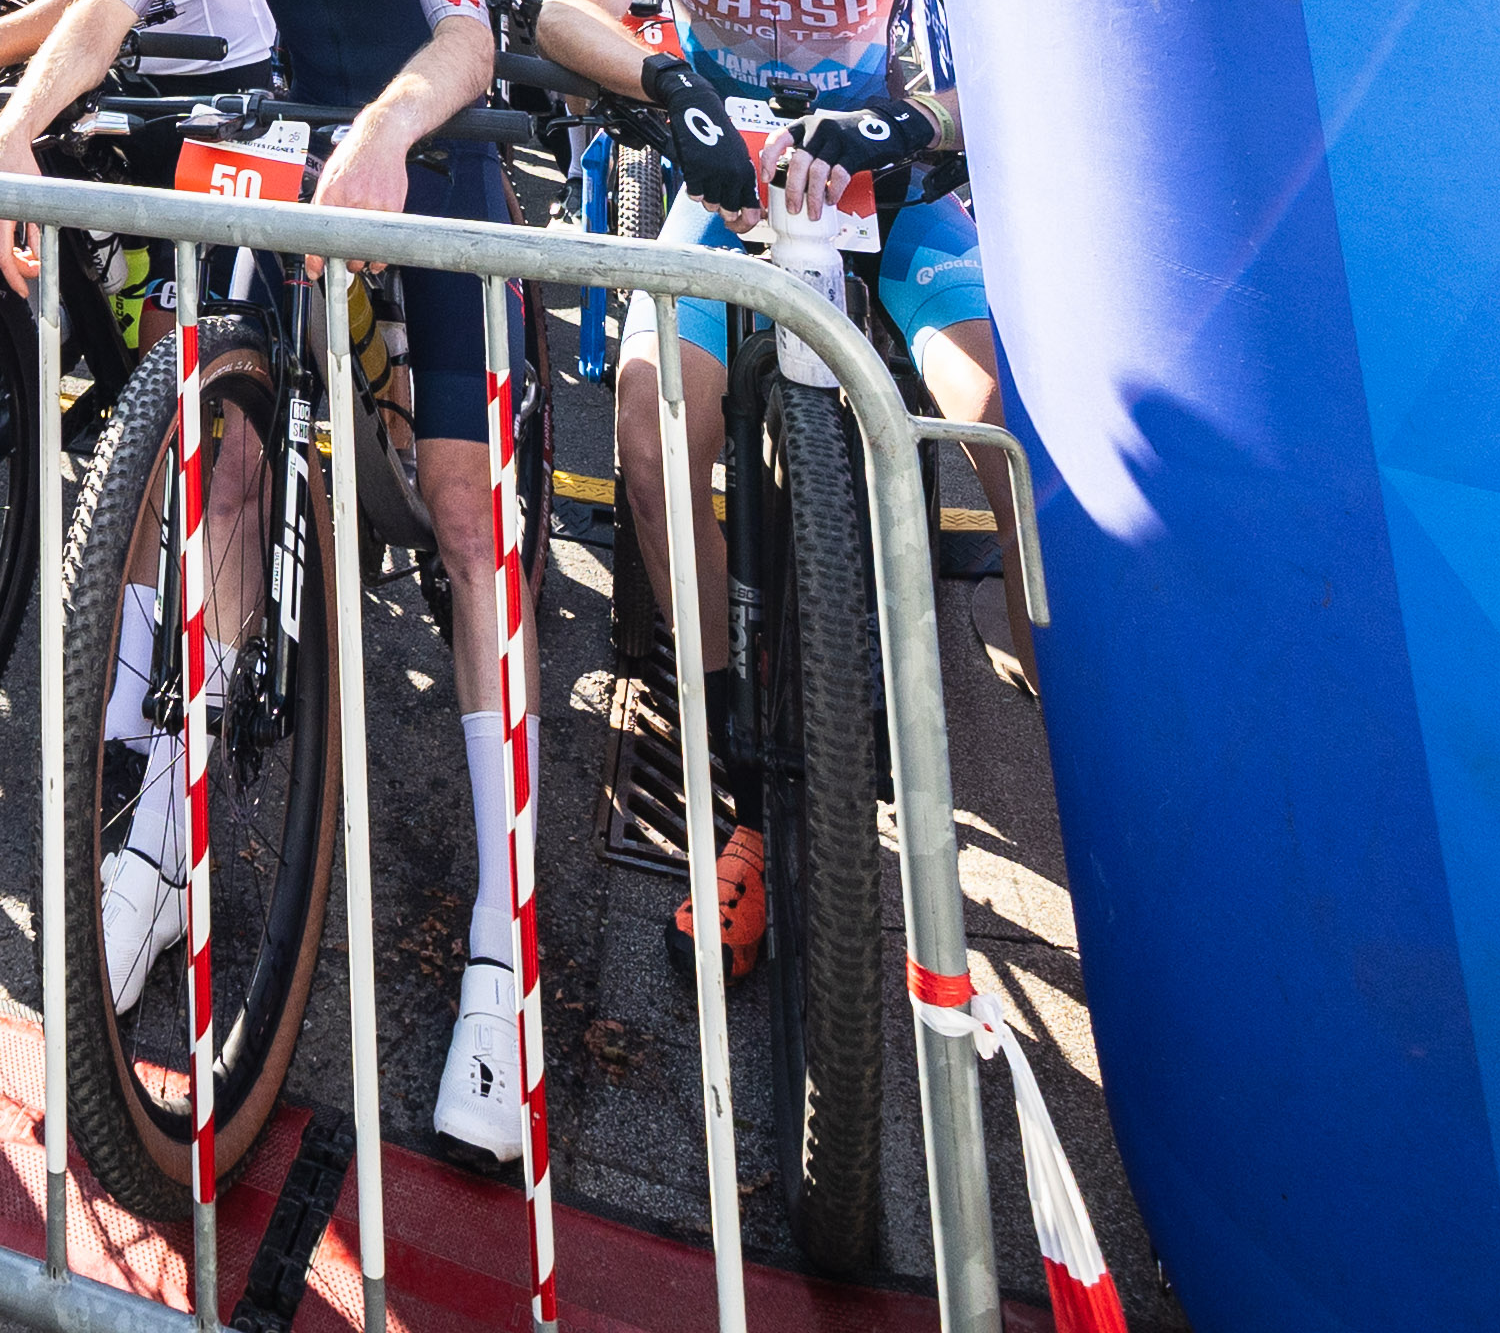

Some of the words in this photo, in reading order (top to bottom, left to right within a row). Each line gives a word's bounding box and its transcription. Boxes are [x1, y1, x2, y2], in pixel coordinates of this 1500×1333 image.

[643, 19, 664, 45] 6
[789, 17, 878, 41] TEAM
[715, 48, 758, 77] JAN
[209, 162, 263, 199] 50
